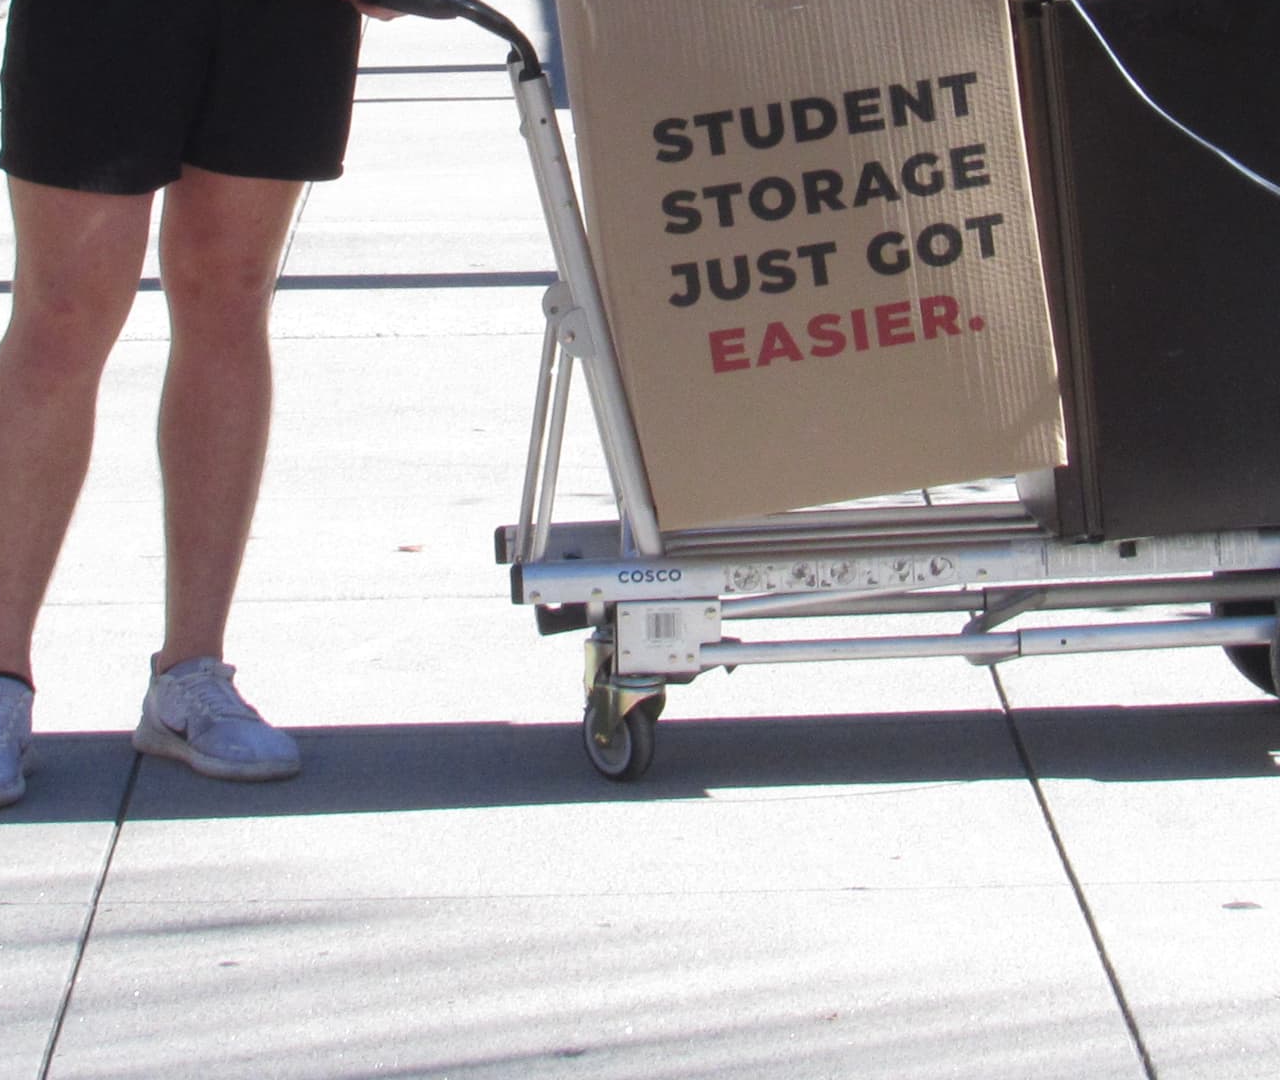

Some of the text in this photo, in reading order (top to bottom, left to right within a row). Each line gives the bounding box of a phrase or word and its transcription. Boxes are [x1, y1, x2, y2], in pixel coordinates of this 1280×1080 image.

[652, 71, 978, 164] STUDENT
[661, 143, 991, 236] STORAGE
[668, 213, 1004, 308] JUST GOT
[708, 295, 986, 374] EASIER.
[618, 569, 682, 584] COSCO
